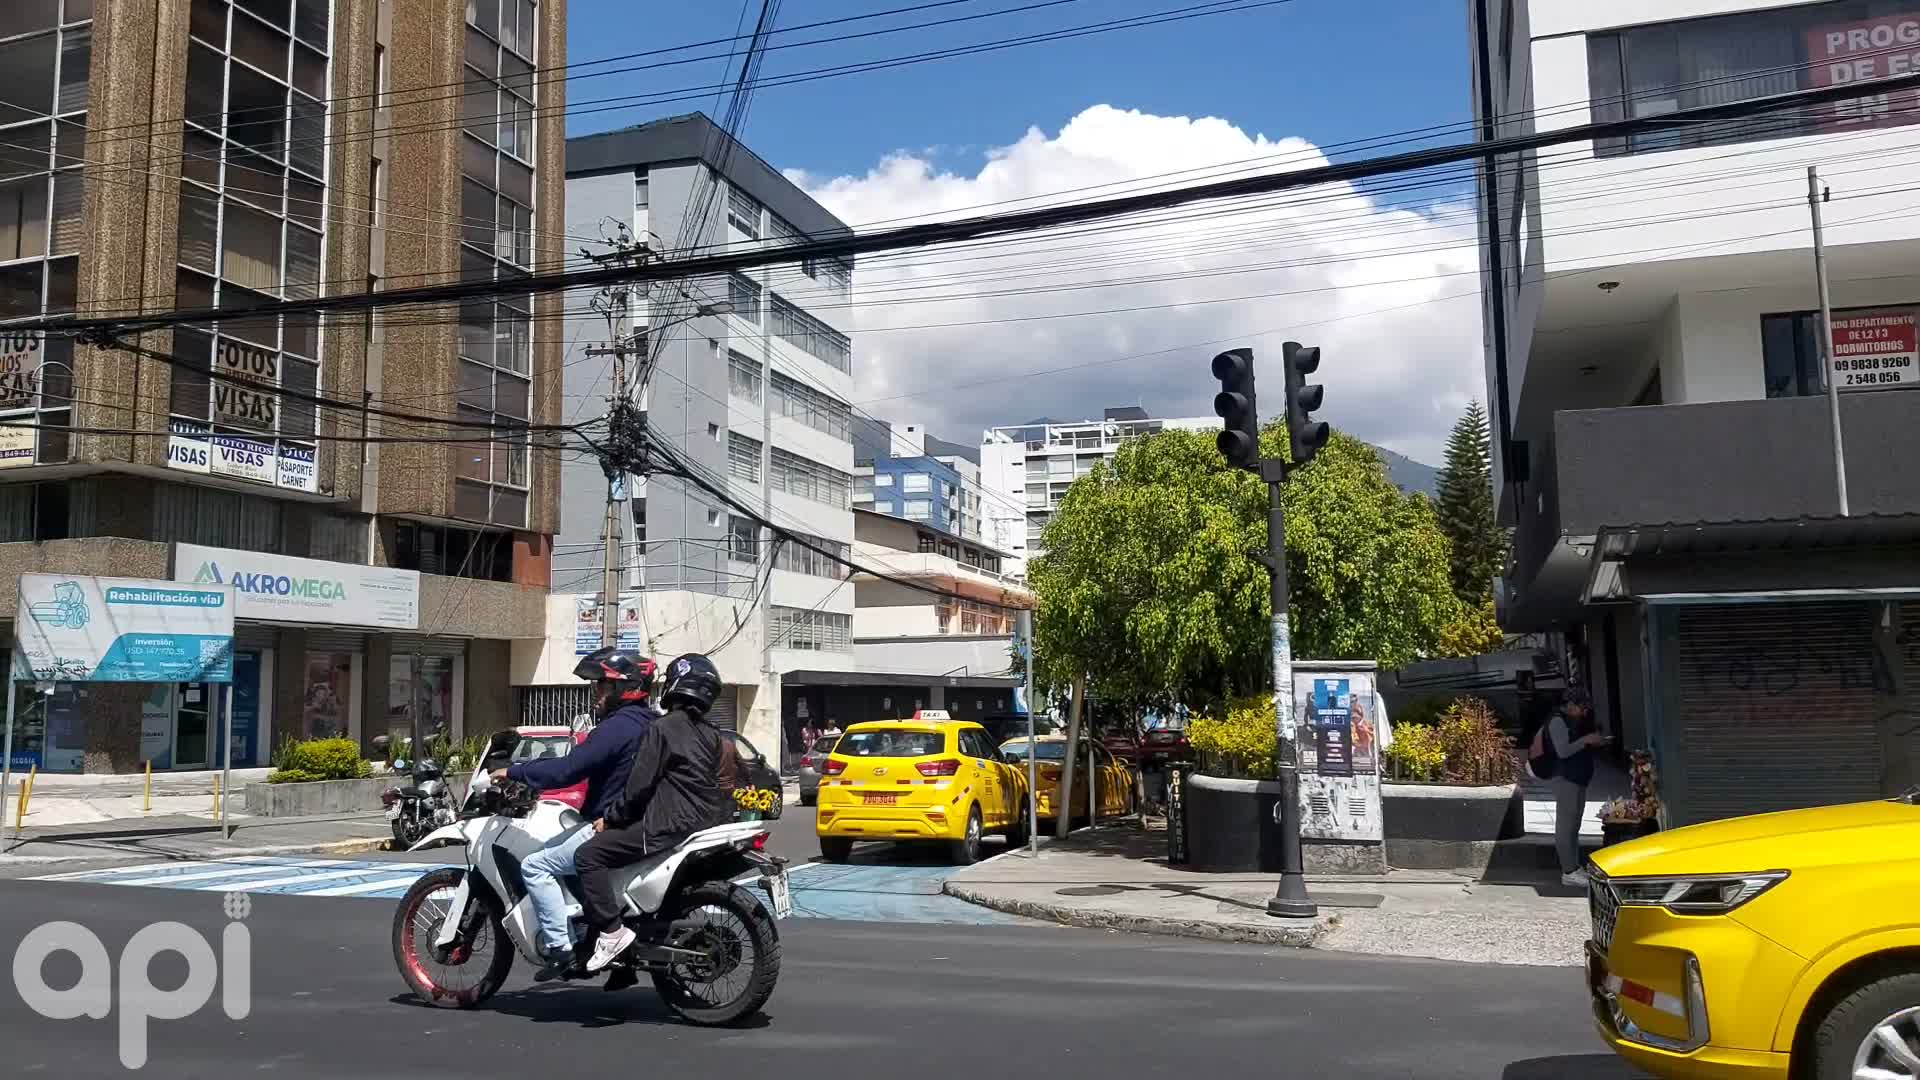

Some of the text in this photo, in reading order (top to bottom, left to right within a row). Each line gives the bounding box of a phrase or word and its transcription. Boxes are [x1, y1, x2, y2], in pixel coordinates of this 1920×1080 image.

[1830, 58, 1874, 84] DE
[1850, 315, 1914, 328] DEPARTAMENTO
[1849, 331, 1860, 340] DE
[1874, 329, 1880, 338] Y
[1882, 328, 1888, 338] 3
[1836, 340, 1904, 353] DORMITORIOS
[216, 341, 276, 377] FOTOS
[1835, 356, 1910, 371] 09 9838 9260
[1846, 371, 1900, 384] 2 548 056
[215, 386, 274, 422] VISAS
[214, 437, 245, 449] FOTO
[168, 445, 207, 466] VISAS
[220, 447, 264, 467] VISAS
[277, 461, 312, 477] PASAPORTE
[282, 475, 307, 488] CARNET
[231, 571, 346, 600] AKROMEGA
[109, 590, 220, 605] Rehabilitación vial
